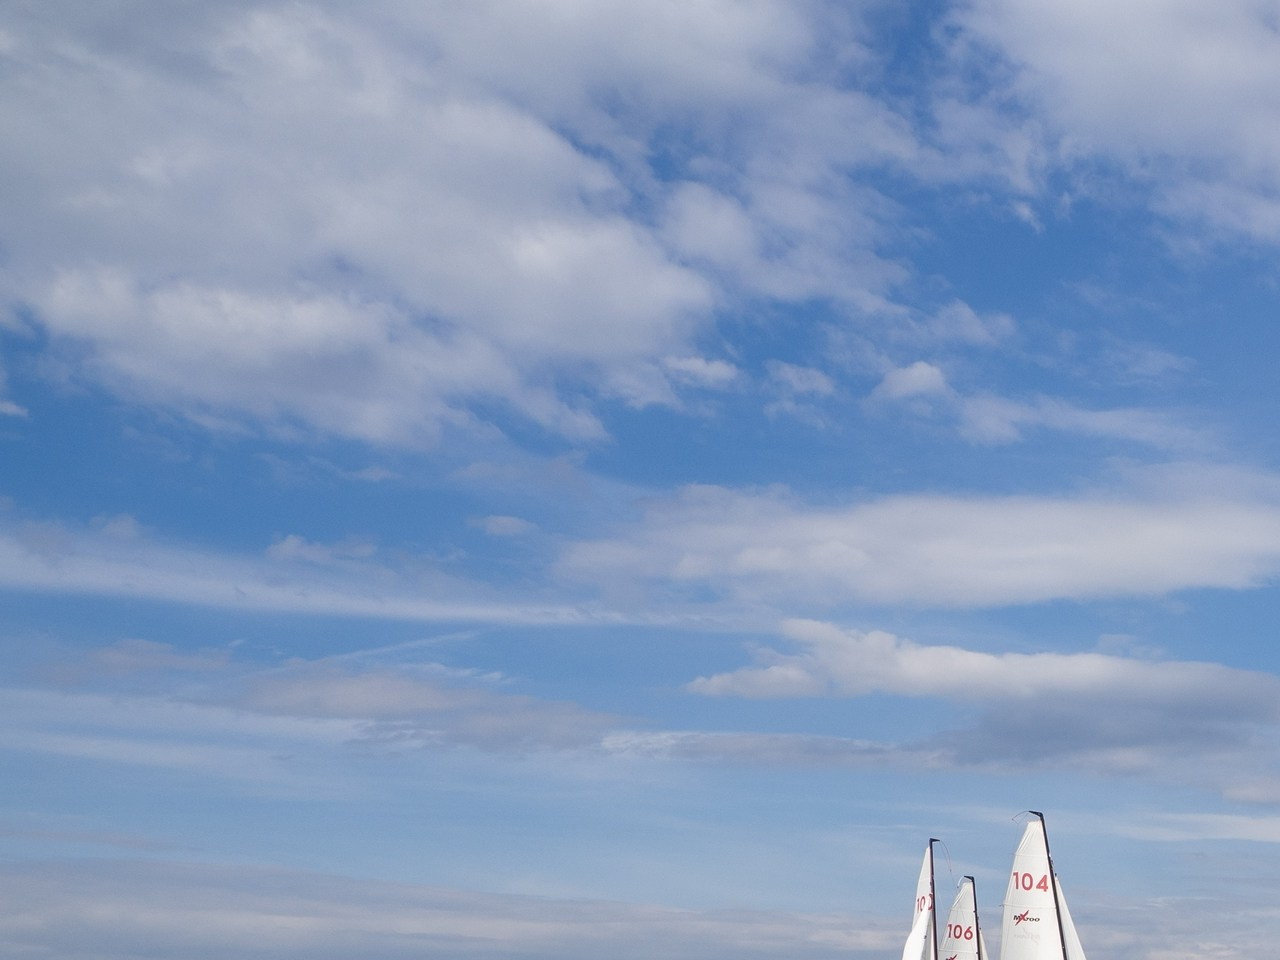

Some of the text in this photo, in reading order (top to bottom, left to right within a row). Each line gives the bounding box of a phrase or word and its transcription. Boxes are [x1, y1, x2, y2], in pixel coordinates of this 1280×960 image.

[1012, 871, 1049, 892] 104
[1013, 910, 1040, 926] MX700
[947, 924, 974, 940] 106
